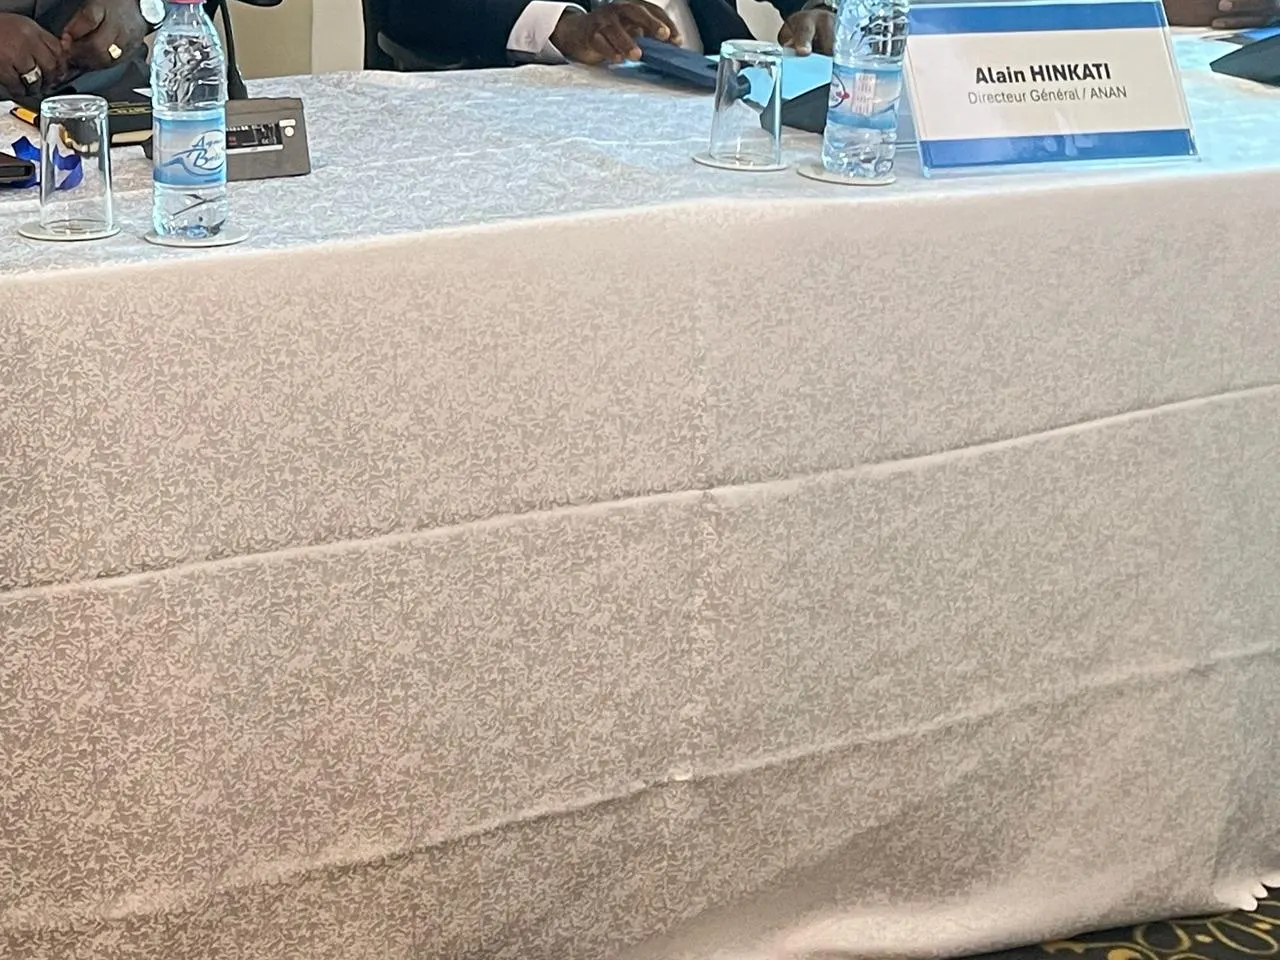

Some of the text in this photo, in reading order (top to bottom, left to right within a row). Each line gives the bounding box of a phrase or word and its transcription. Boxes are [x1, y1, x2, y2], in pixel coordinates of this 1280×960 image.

[975, 62, 1112, 84] Alain HINKATI
[967, 91, 1027, 105] Directeur
[1029, 88, 1080, 102] Général
[1090, 86, 1128, 100] ANAN
